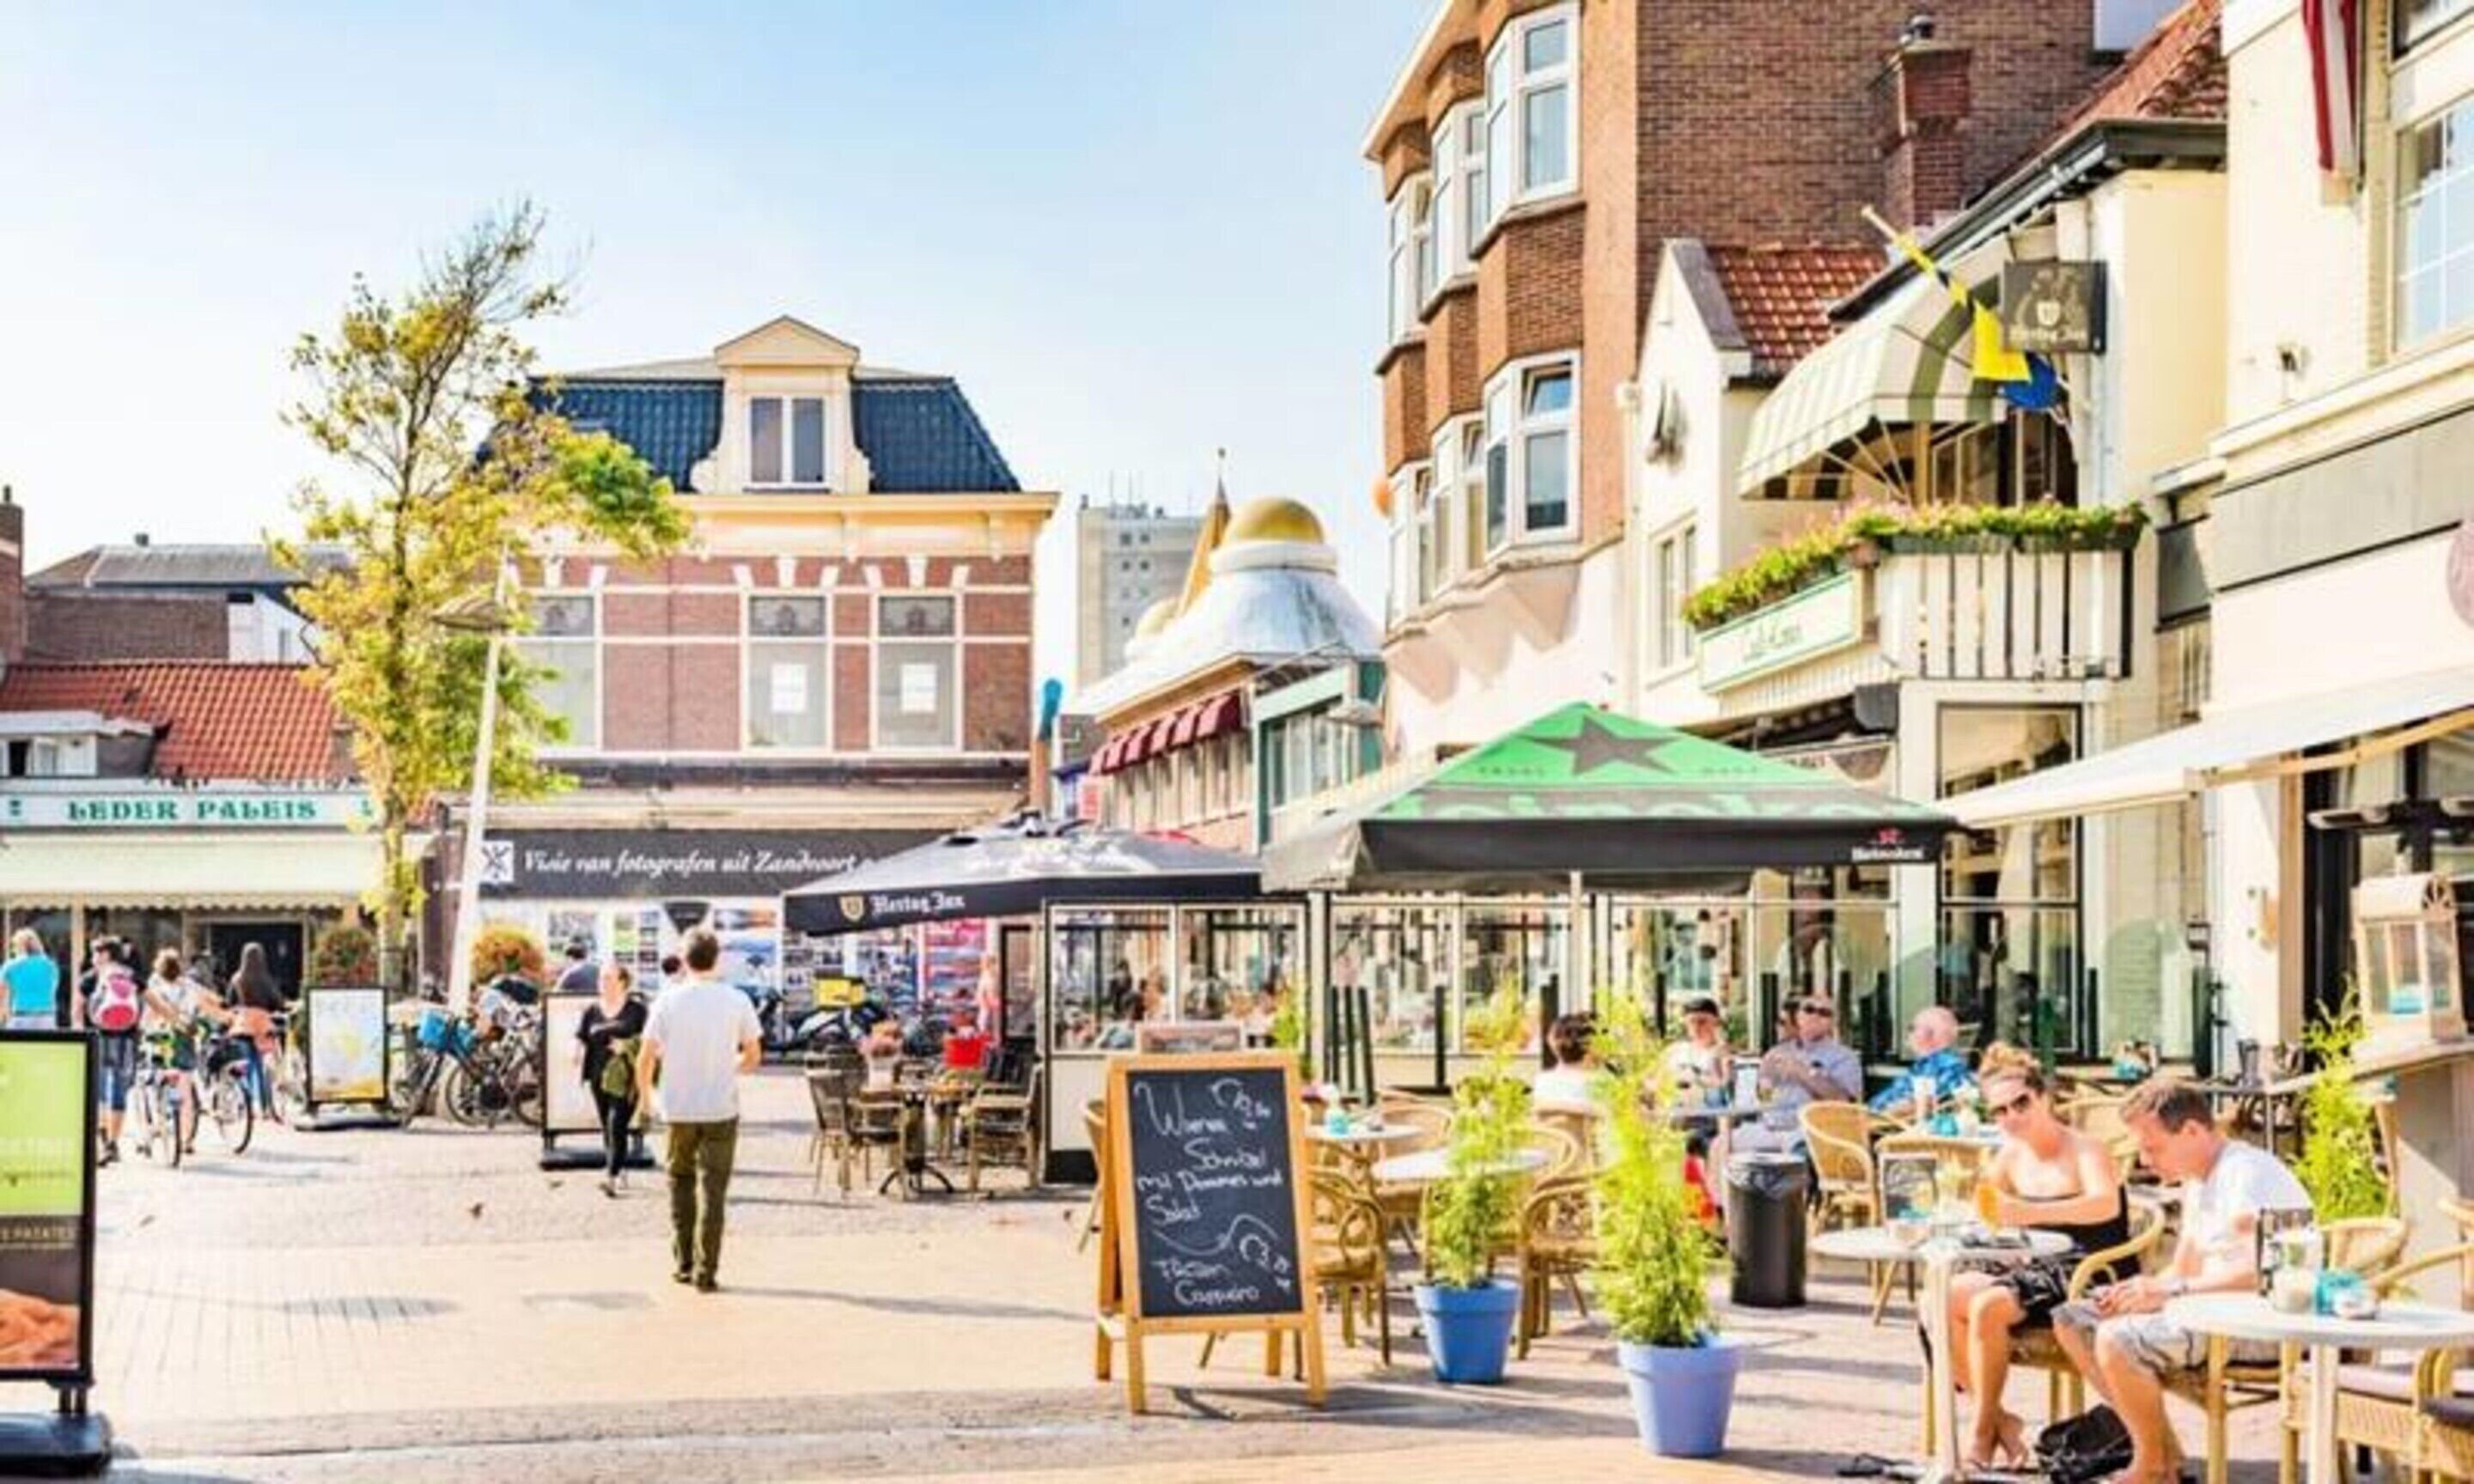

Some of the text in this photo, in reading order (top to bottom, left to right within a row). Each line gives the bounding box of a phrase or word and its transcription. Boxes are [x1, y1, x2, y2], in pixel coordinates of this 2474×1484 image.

[67, 799, 319, 821] LEDER PALEIS
[574, 855, 612, 873] van
[611, 848, 716, 879] fotografen
[720, 849, 750, 874] uit
[752, 848, 859, 874] Zandvoort
